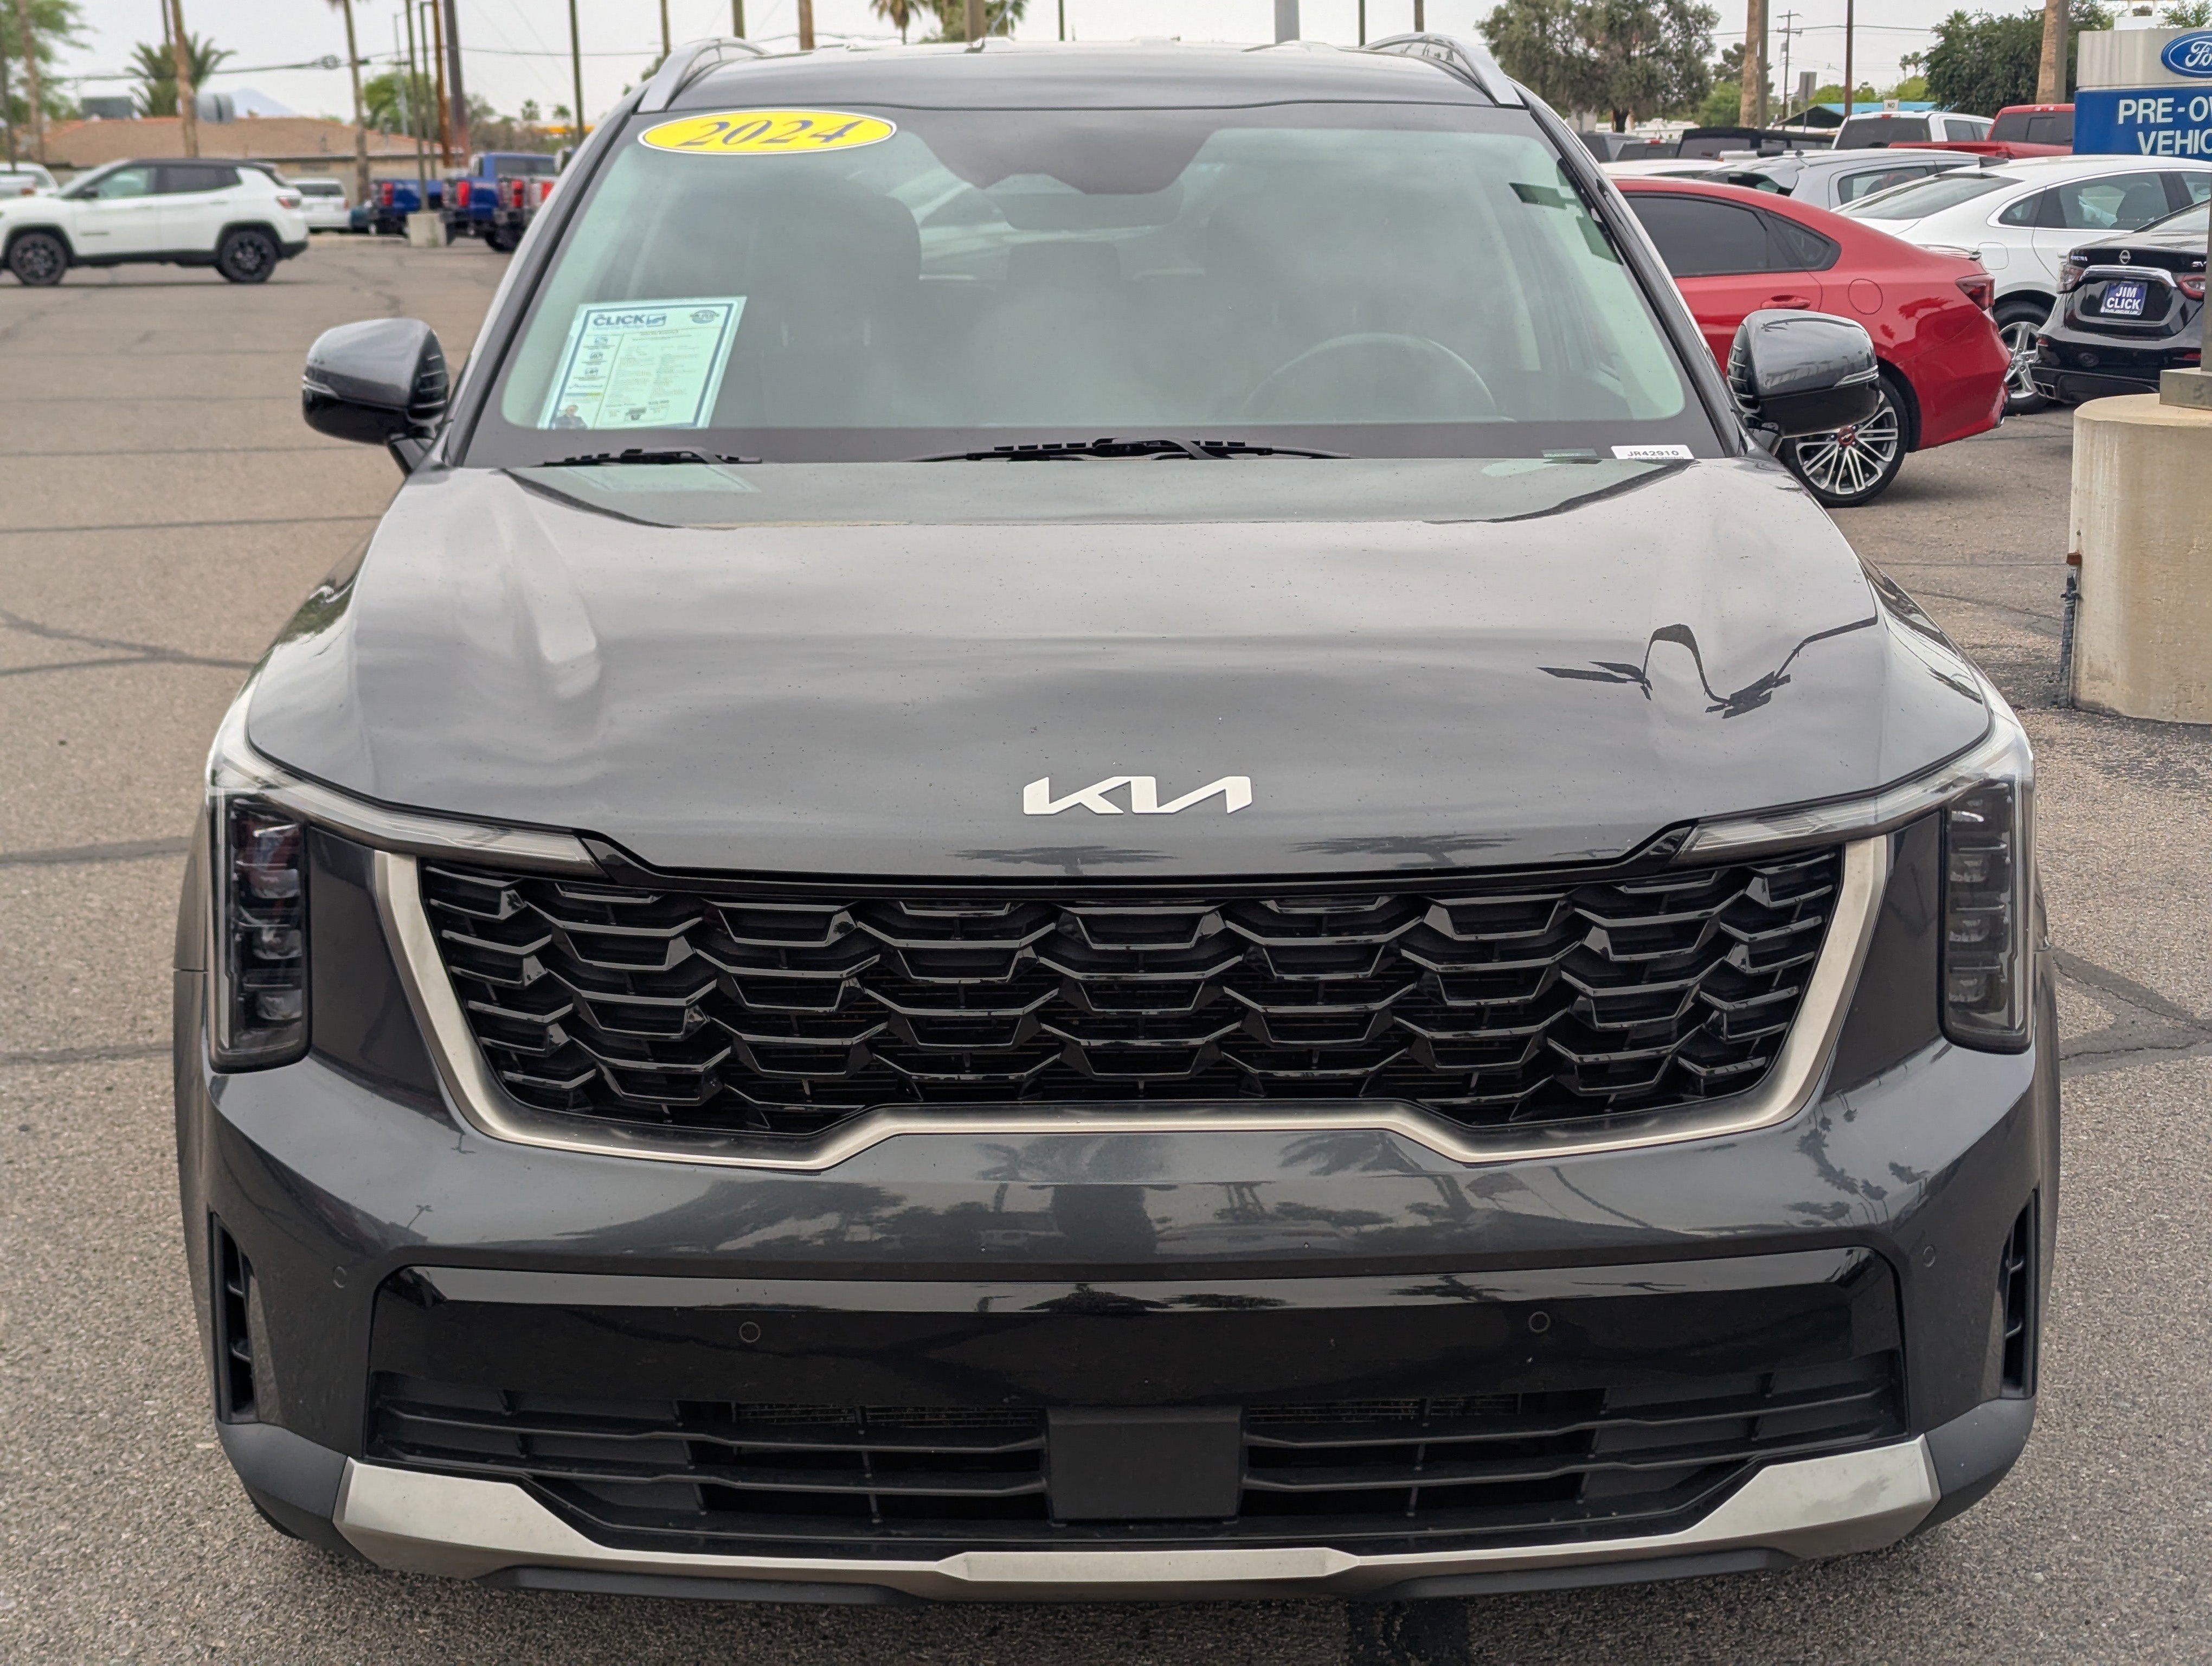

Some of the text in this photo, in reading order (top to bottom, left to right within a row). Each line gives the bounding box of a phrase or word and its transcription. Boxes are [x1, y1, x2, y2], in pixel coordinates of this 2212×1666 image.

[2185, 41, 2212, 67] Fo
[2118, 96, 2212, 125] PRE-O
[676, 120, 865, 146] 2024
[2106, 297, 2141, 310] CLICK
[2115, 286, 2138, 298] JIM
[594, 315, 646, 326] CLICK
[1023, 776, 1253, 815] KIA
